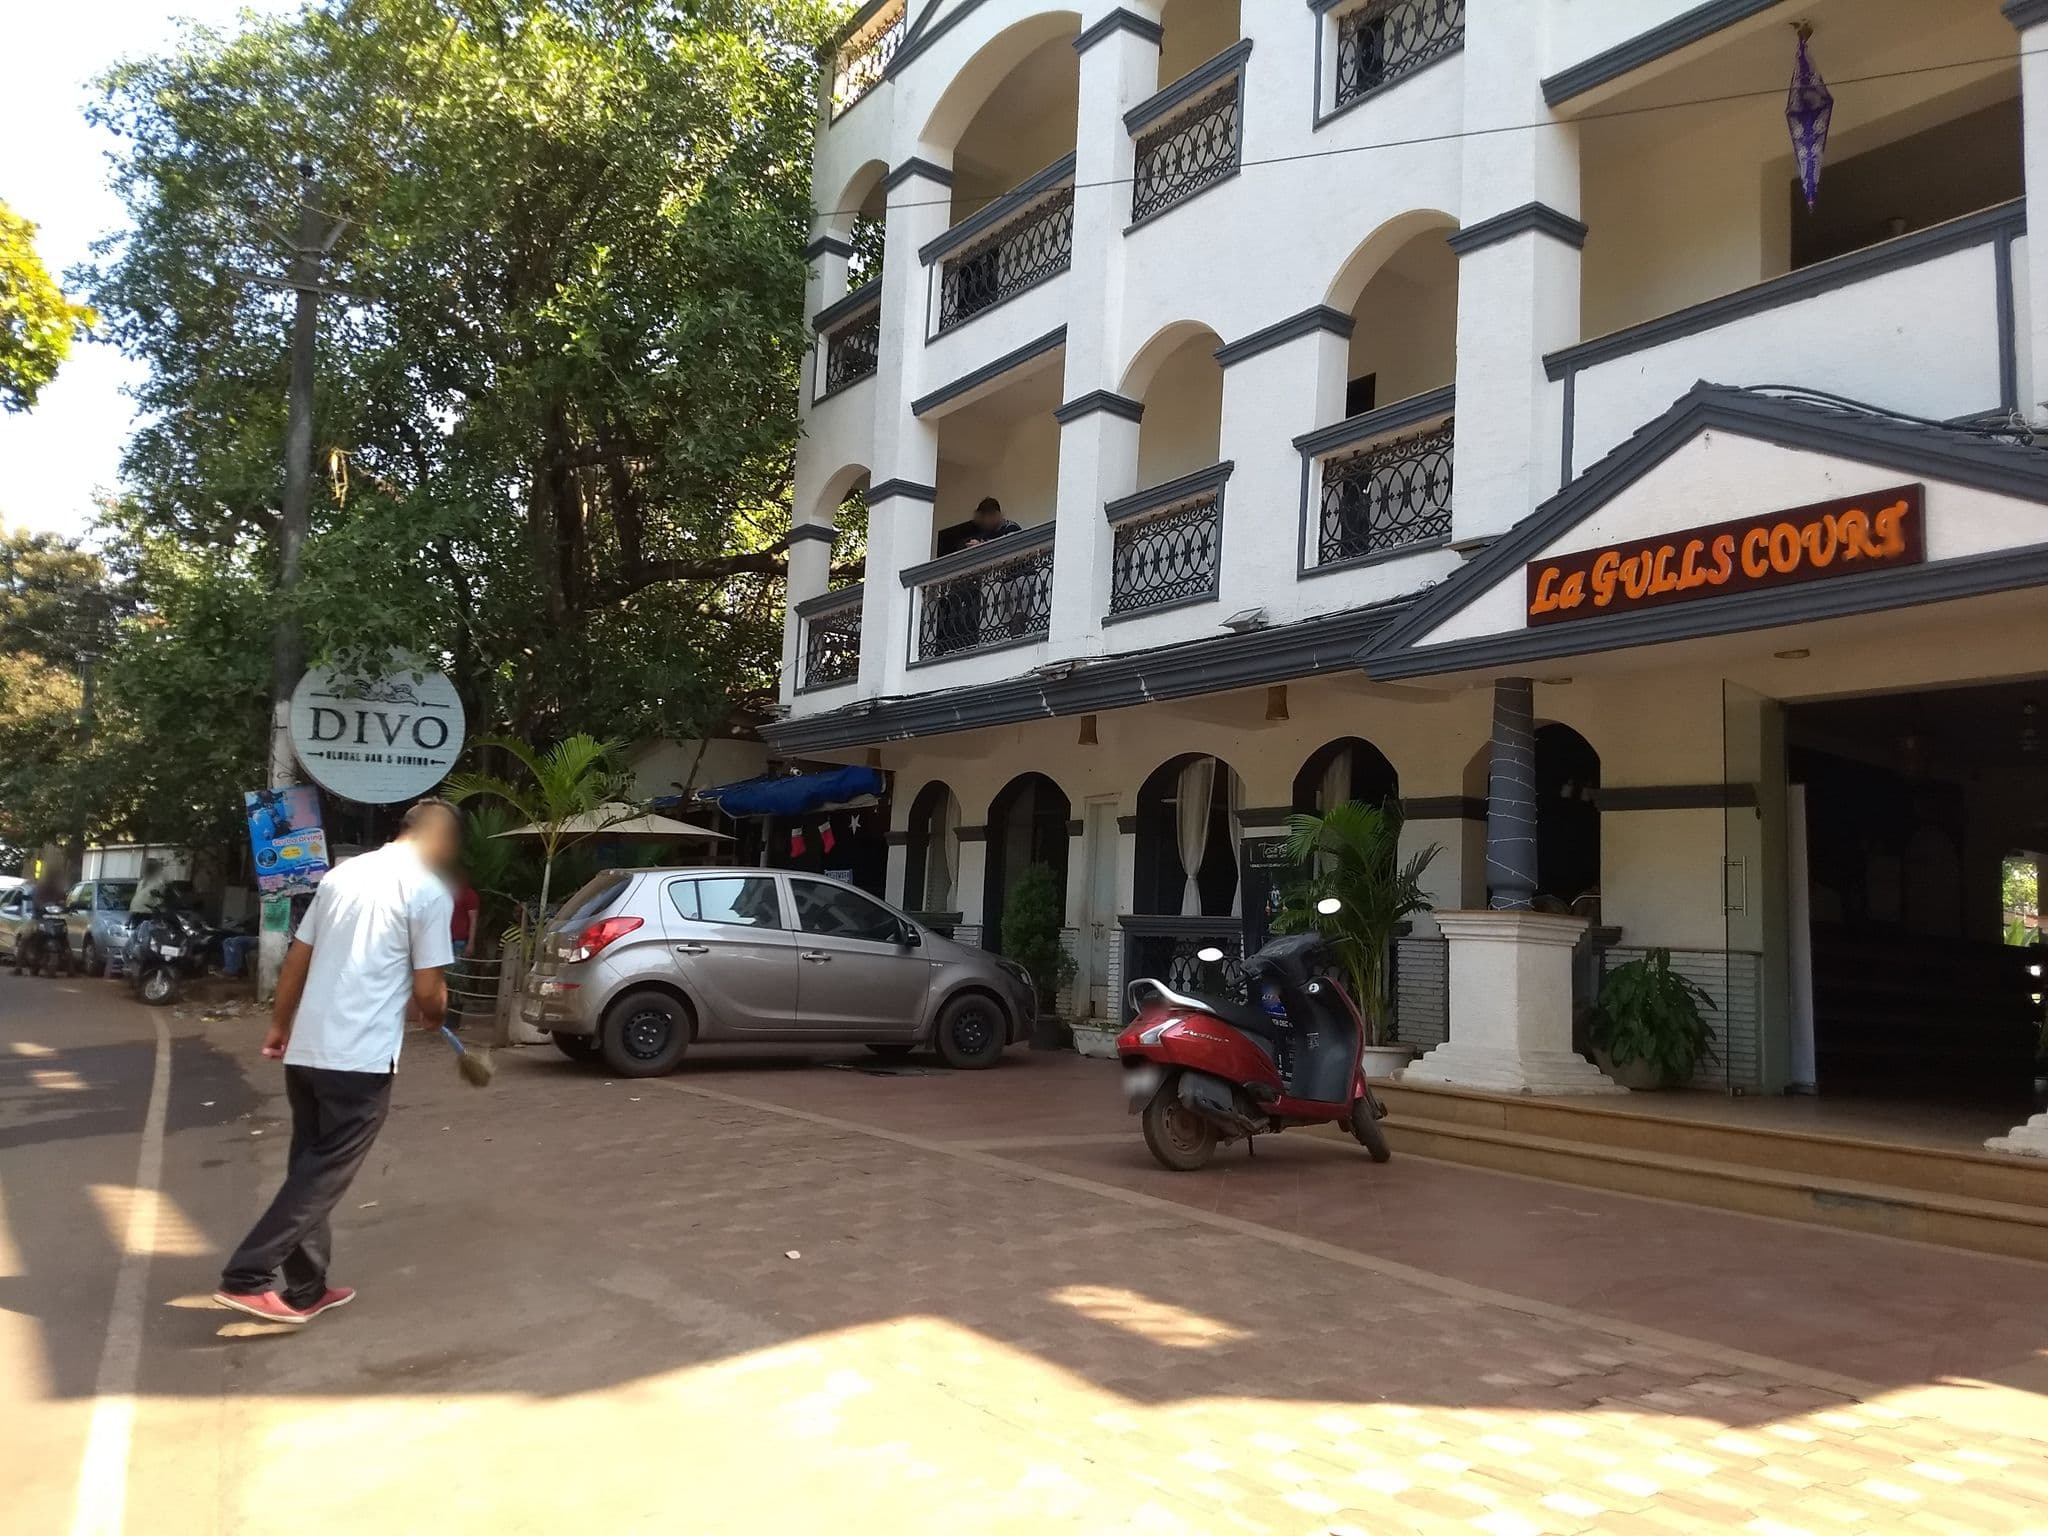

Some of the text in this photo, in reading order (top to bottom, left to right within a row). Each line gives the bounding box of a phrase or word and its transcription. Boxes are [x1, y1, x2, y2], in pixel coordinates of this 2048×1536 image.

[1530, 500, 1909, 616] La GULLS COURT
[308, 706, 450, 750] DIVO
